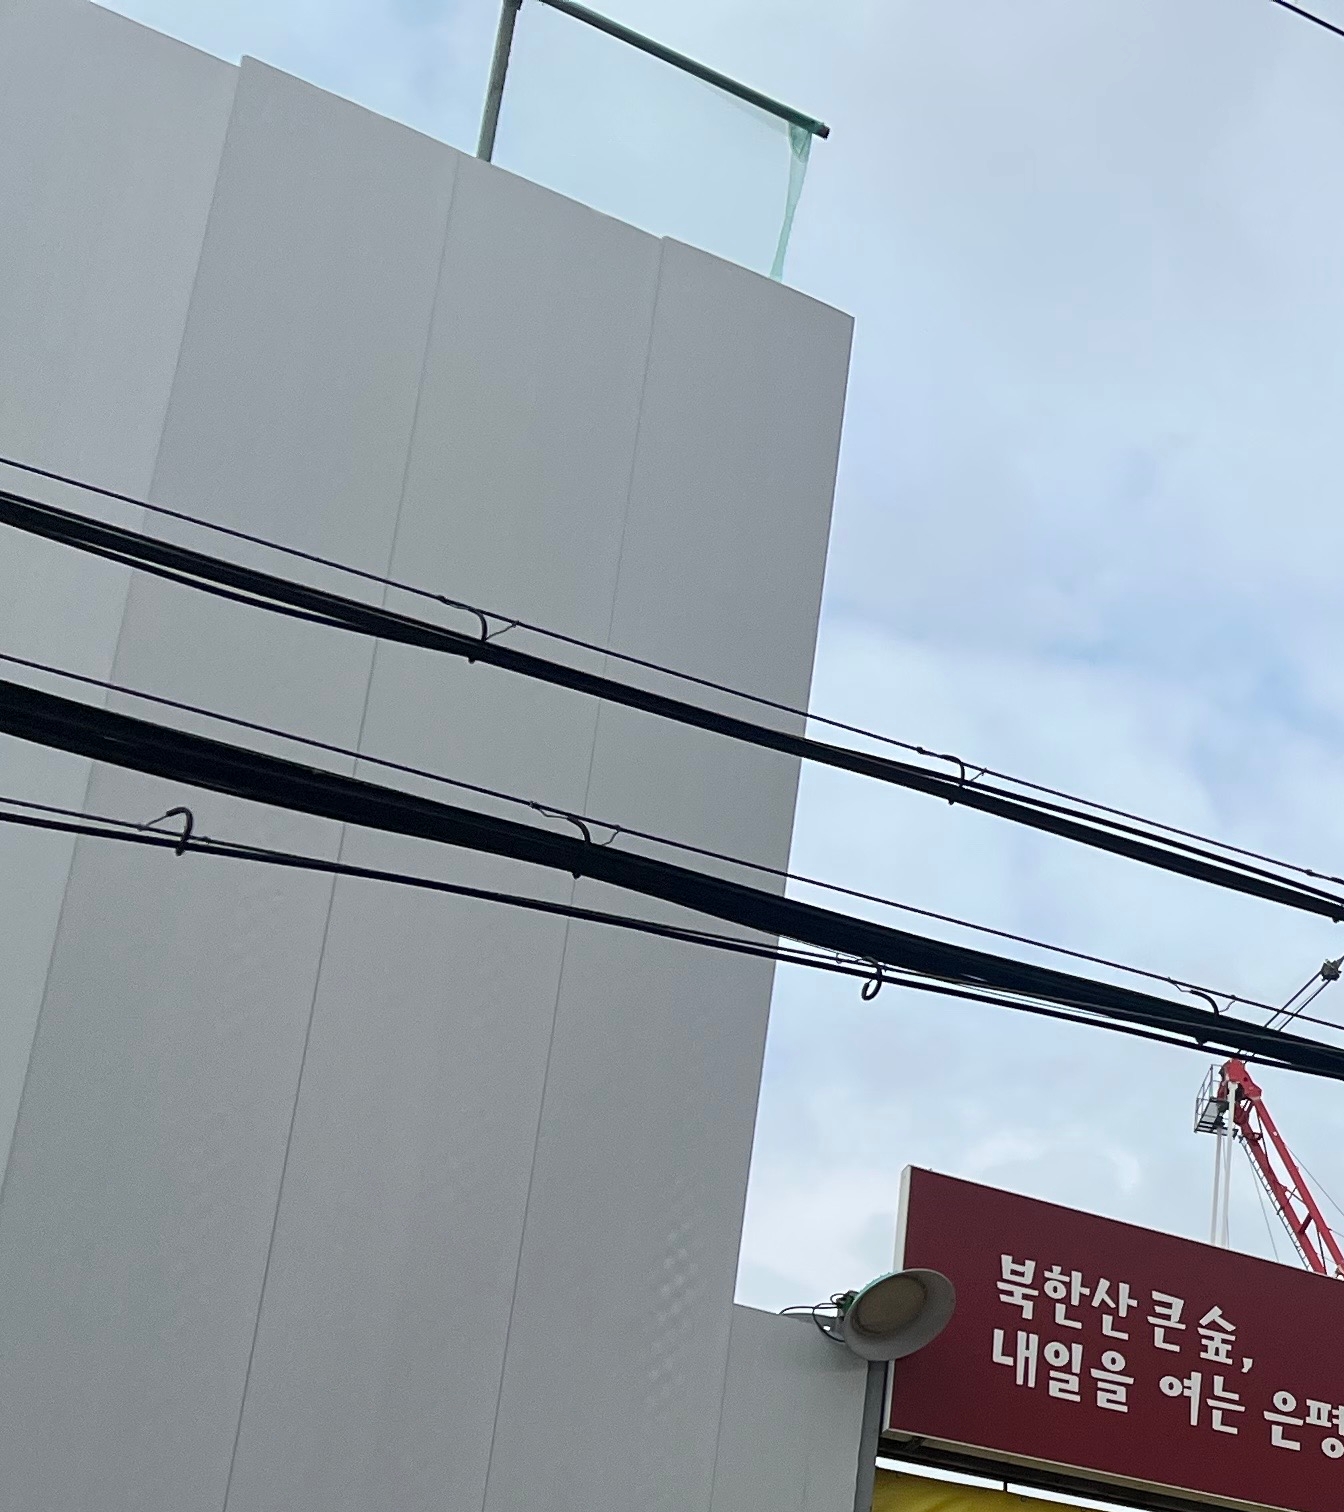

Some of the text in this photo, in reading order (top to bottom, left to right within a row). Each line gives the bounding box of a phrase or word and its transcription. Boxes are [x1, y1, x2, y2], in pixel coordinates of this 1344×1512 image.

[997, 1253, 1254, 1375] 북한산 큰 숲,
[991, 1327, 1134, 1413] 내일을
[1159, 1370, 1246, 1436] 여는
